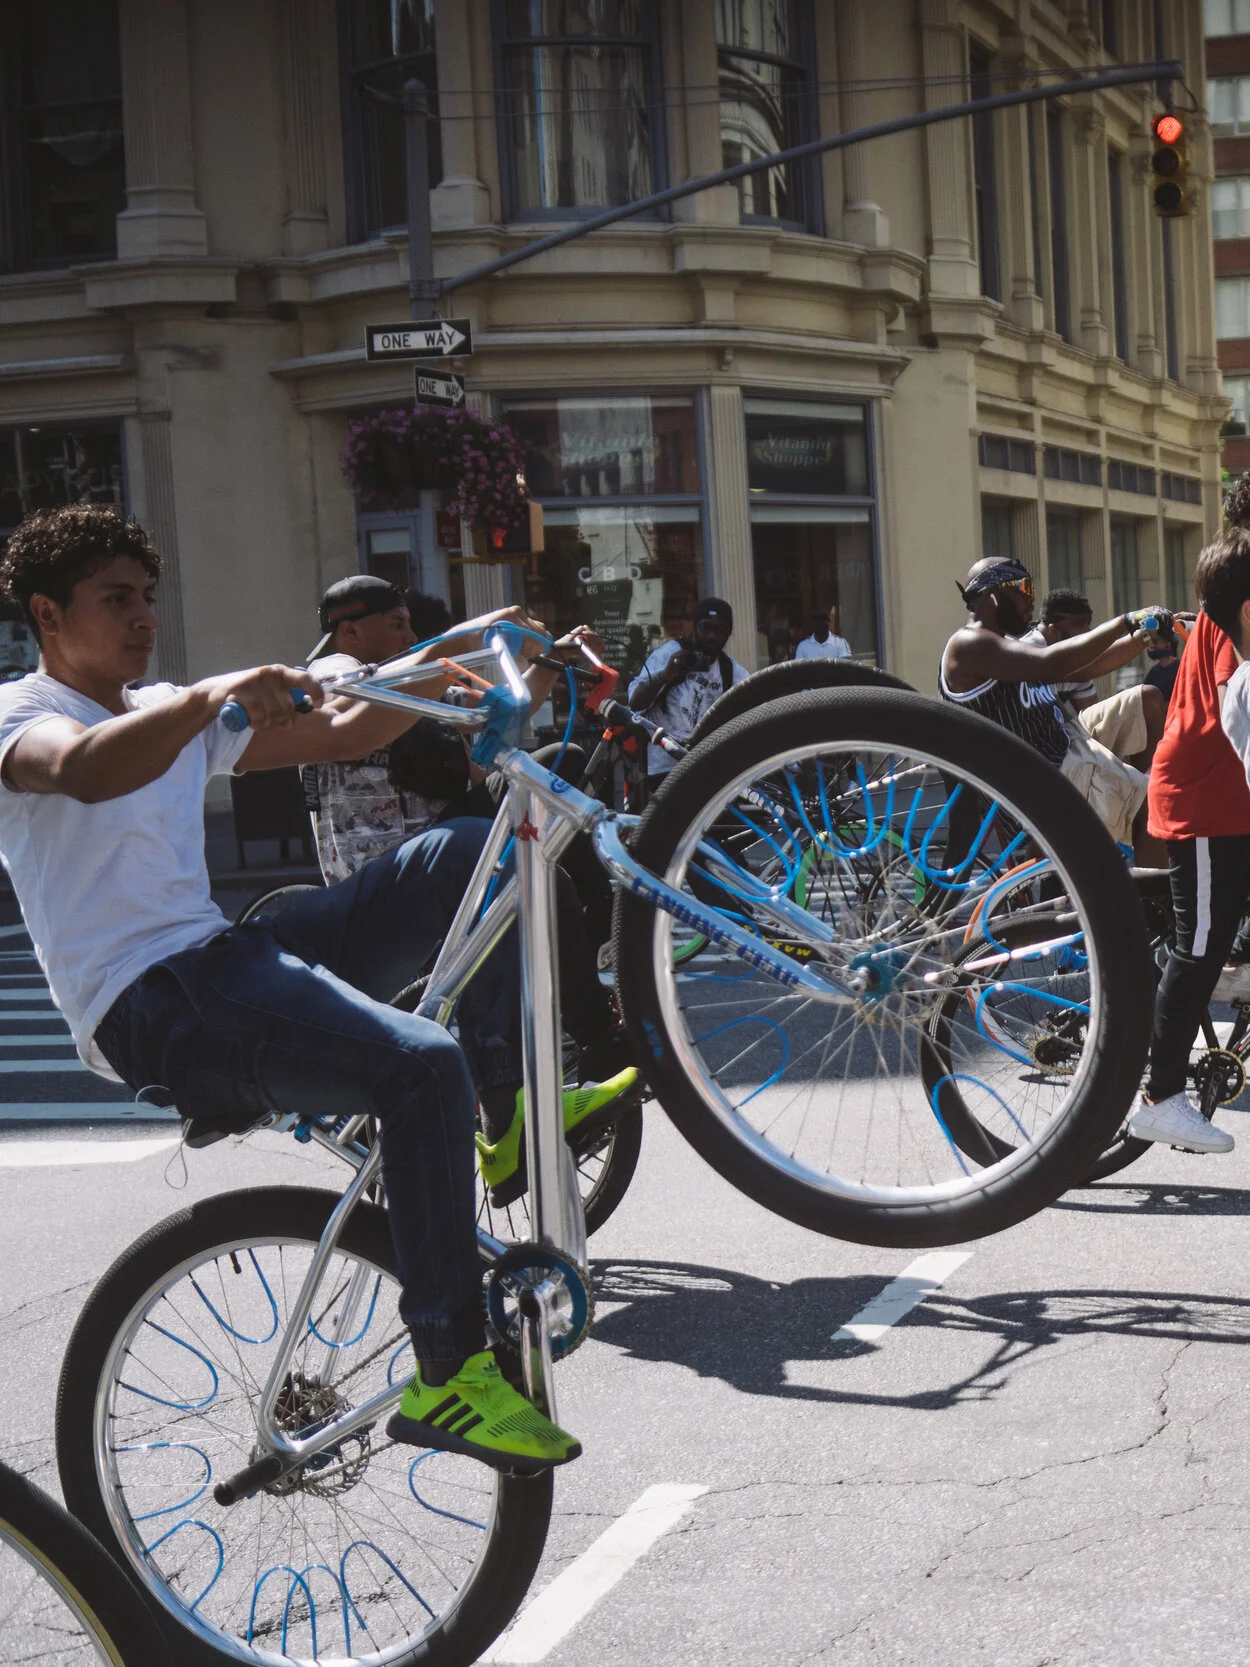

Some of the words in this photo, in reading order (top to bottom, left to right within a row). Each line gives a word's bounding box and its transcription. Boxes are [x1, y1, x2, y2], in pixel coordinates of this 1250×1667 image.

[381, 334, 411, 349] ONE
[424, 331, 455, 346] WAY
[419, 379, 436, 394] ONE
[444, 383, 459, 398] WAY
[767, 432, 832, 451] Vitamin
[763, 450, 824, 467] Shoppe
